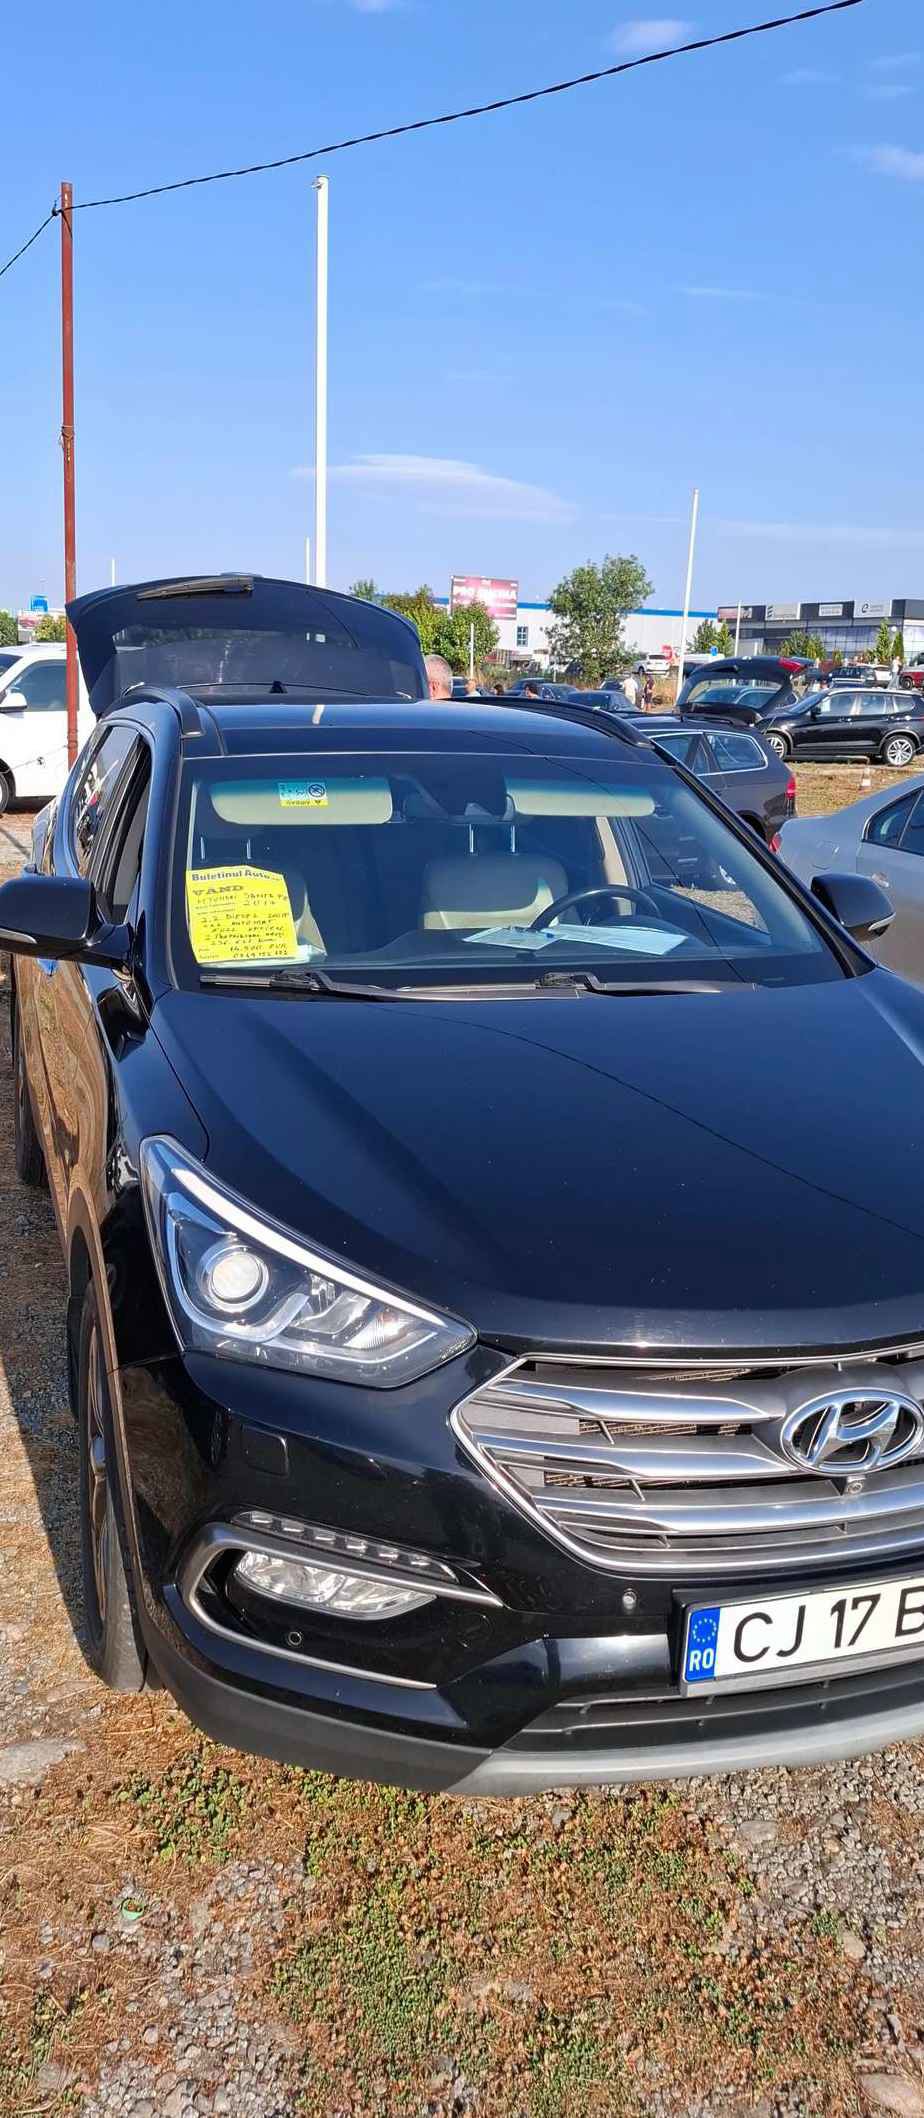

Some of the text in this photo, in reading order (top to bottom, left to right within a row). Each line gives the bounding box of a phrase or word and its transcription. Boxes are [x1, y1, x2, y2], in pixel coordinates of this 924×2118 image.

[192, 870, 242, 881] Buletinul
[244, 869, 270, 880] Auto
[733, 1585, 924, 1663] CJ 17 B
[688, 1647, 715, 1673] RO
